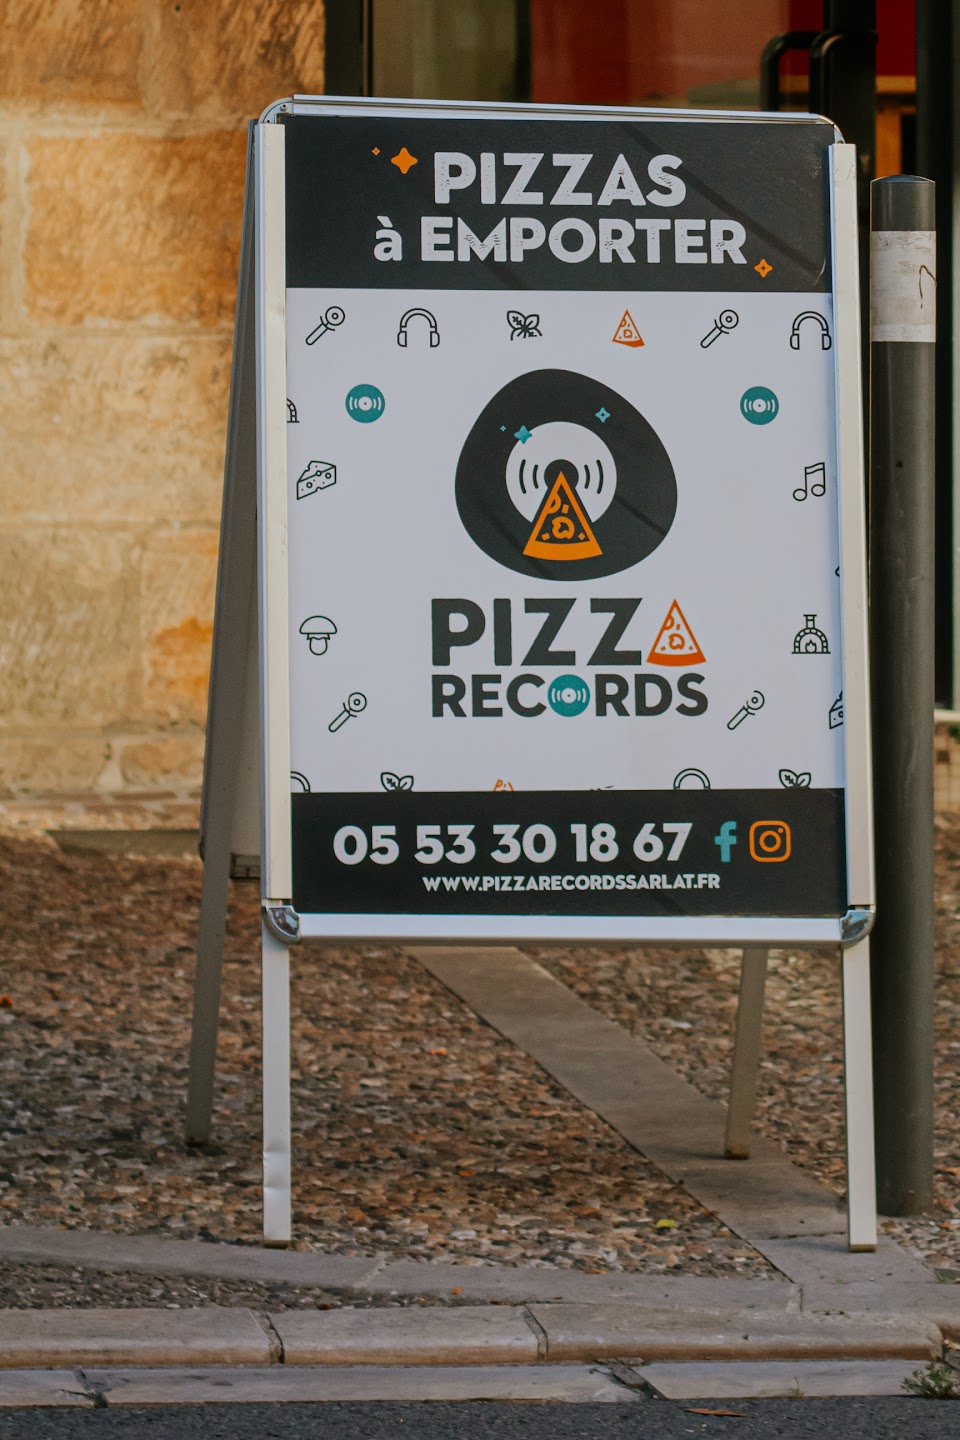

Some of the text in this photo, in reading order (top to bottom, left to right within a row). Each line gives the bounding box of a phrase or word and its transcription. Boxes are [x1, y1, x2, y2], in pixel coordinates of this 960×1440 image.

[433, 151, 687, 207] PIZZAS
[373, 215, 748, 265] à EMPORTER
[431, 672, 709, 718] RECORDS
[332, 822, 693, 865] 05 53 30 18 67
[421, 873, 721, 892] WWW.PIZZARECORDSSARLAT.FR
